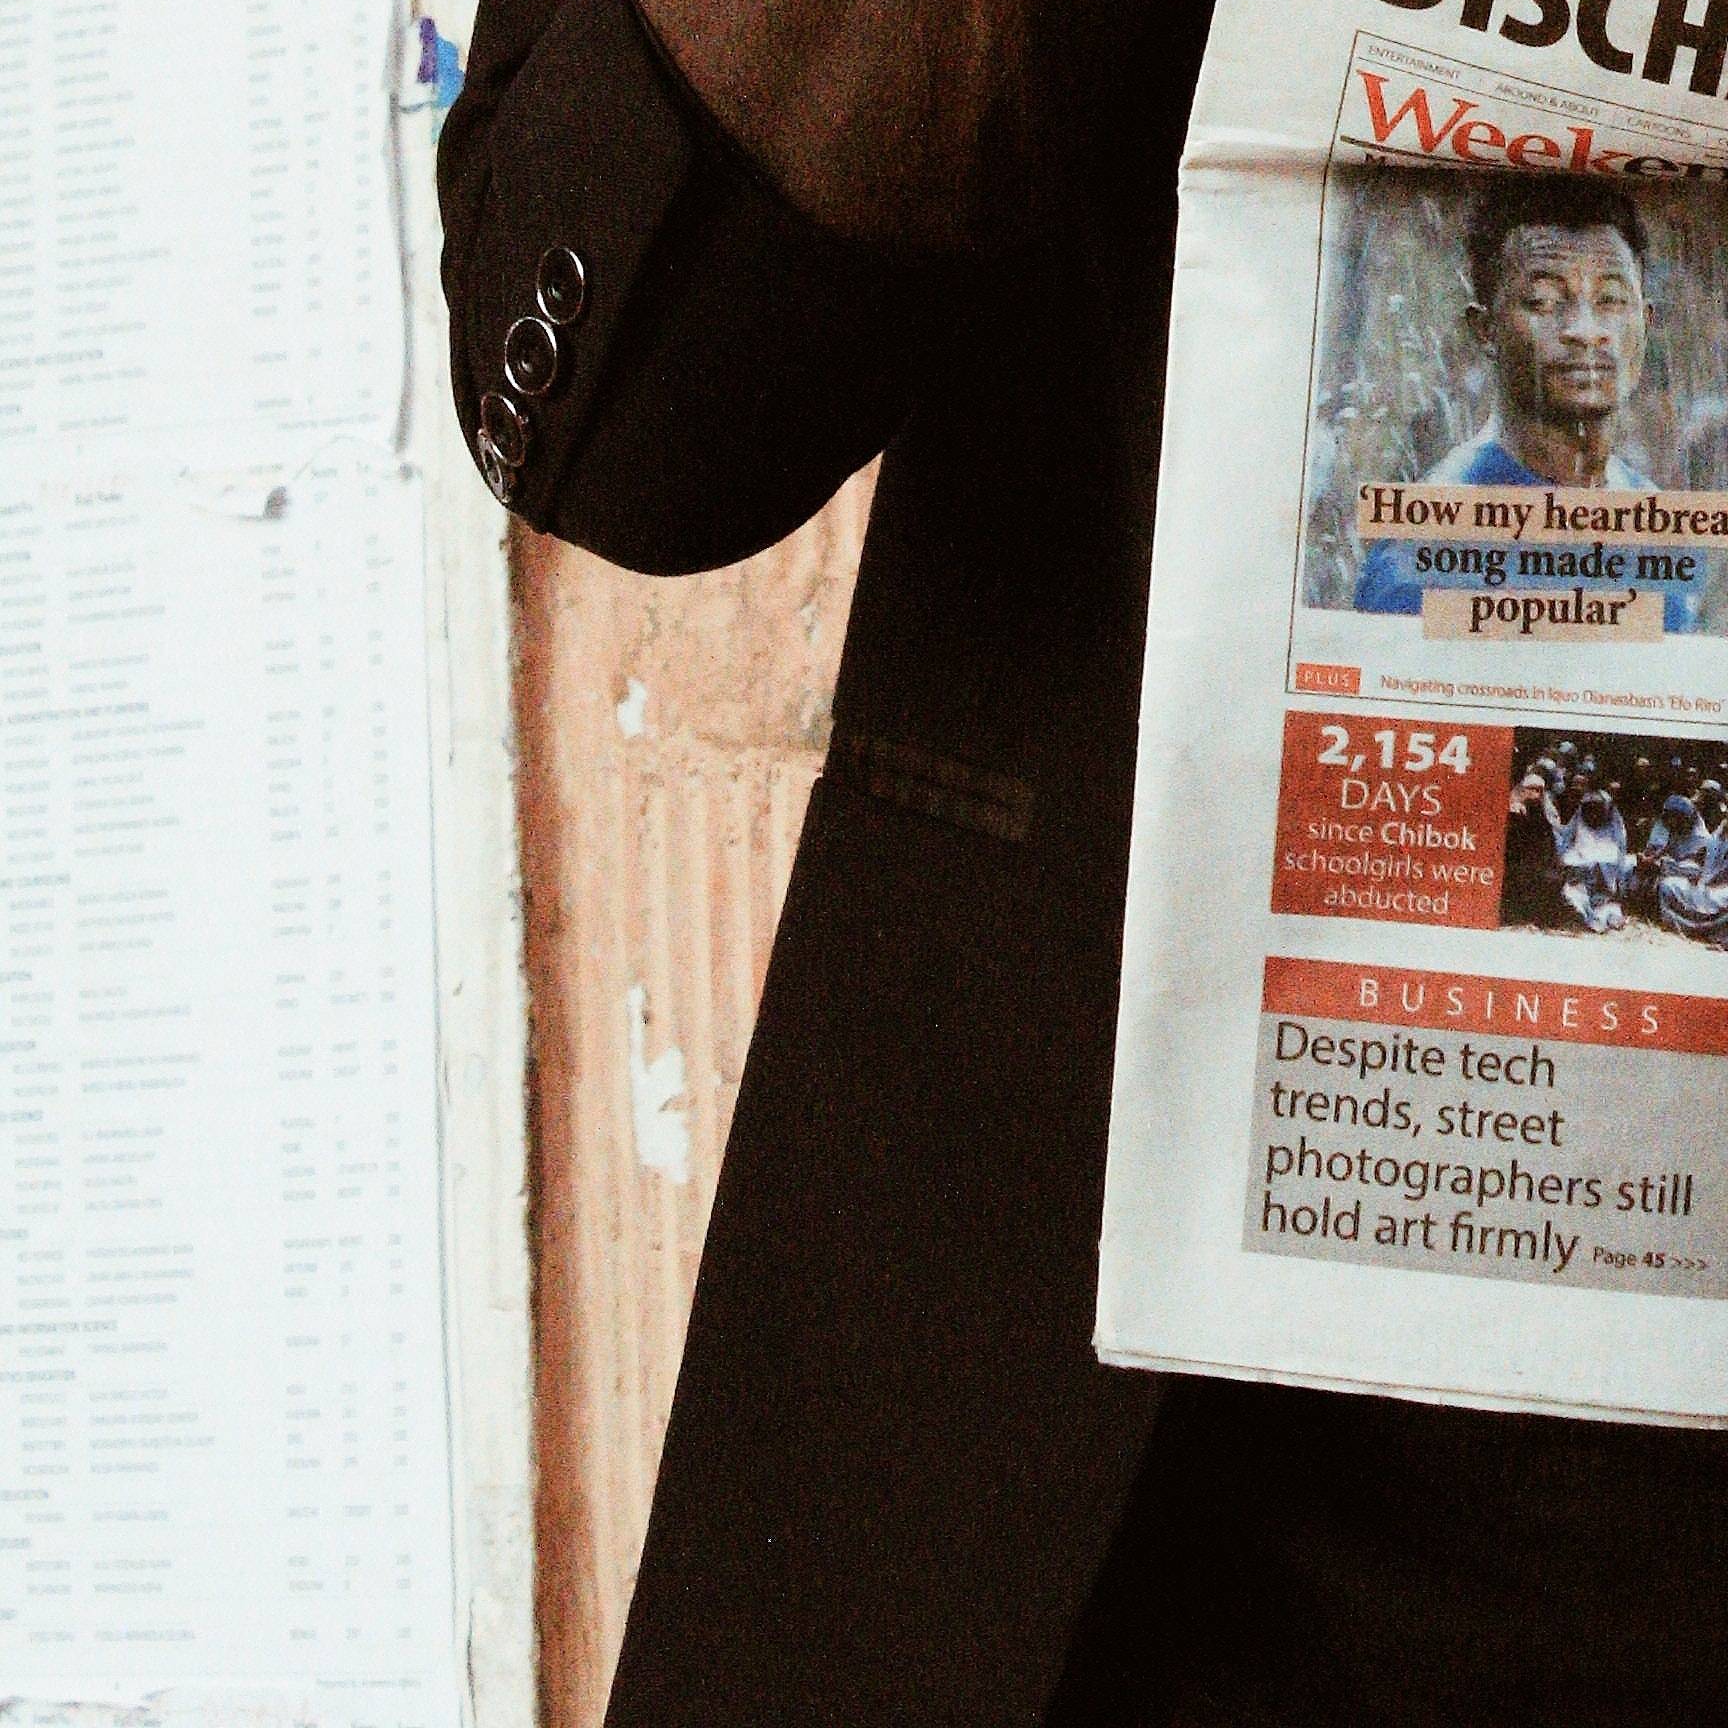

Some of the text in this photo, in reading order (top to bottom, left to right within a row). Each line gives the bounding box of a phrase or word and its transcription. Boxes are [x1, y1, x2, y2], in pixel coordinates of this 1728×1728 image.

[1473, 498, 1534, 539] my
[1415, 543, 1697, 586] song made me
[1317, 725, 1472, 775] 2,154
[1340, 780, 1444, 817] DAYS
[1306, 817, 1477, 852] since Chibok
[1283, 850, 1495, 886] schoolgirls were
[1323, 887, 1450, 914] abducted
[1360, 978, 1660, 1034] BUSINESS
[1275, 1020, 1557, 1089] Despite tech
[1270, 1081, 1565, 1148] trends, street
[1266, 1137, 1694, 1217] photographers still
[1261, 1192, 1360, 1243] hold
[1374, 1212, 1438, 1253] art
[1447, 1211, 1581, 1275] firmly
[1593, 1246, 1638, 1270] Page
